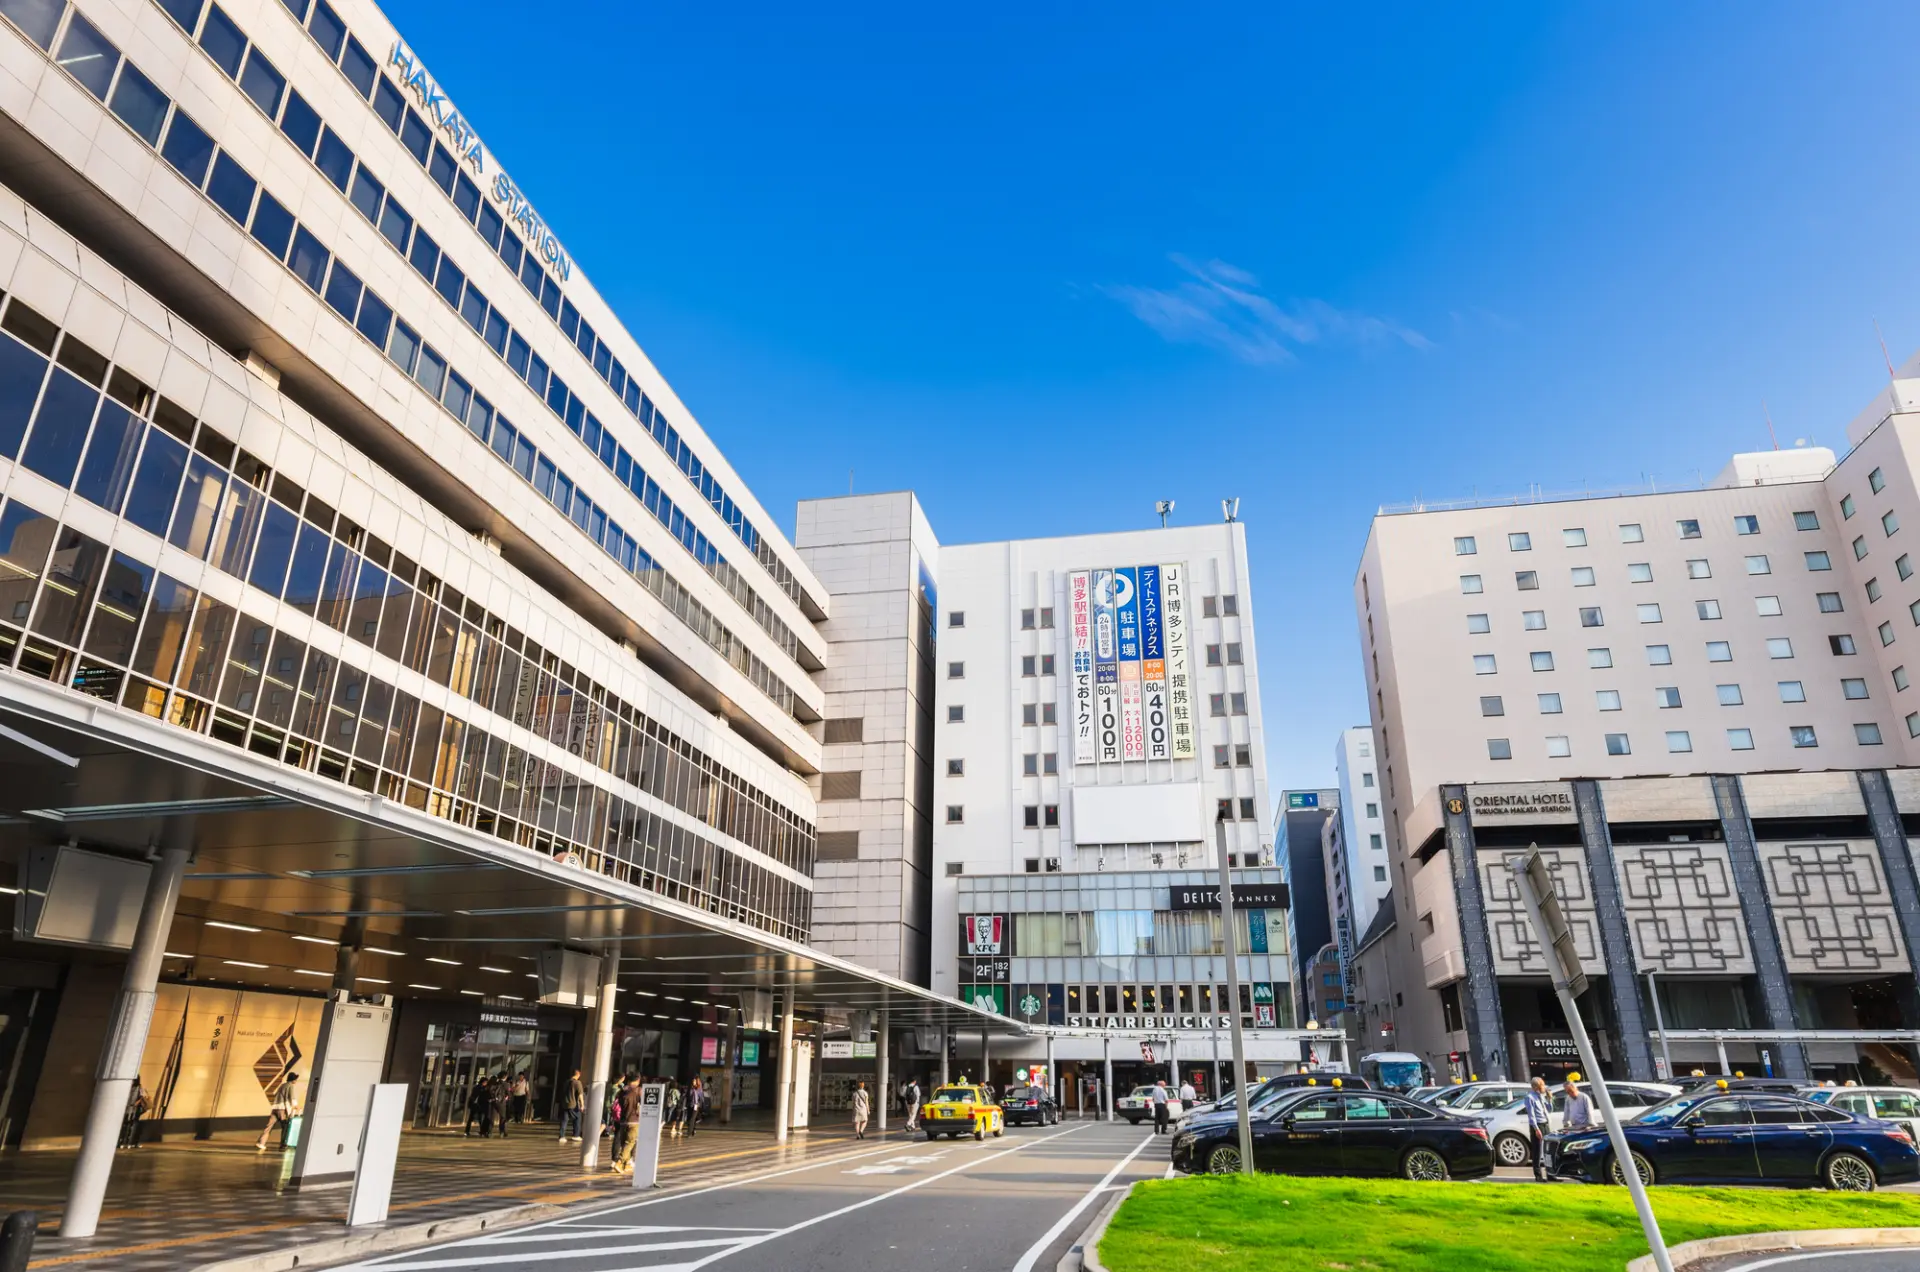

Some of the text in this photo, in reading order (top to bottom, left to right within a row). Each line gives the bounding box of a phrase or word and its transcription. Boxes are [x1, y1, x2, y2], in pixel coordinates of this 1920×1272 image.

[390, 39, 571, 281] HAKATA STATION
[1143, 570, 1159, 655] デイトスアネックス
[1120, 611, 1137, 656] 駐車場
[1167, 569, 1191, 753] JR博多シティ提携駐車場
[1098, 685, 1117, 696] 60分
[1146, 682, 1164, 692] 60分
[1077, 674, 1090, 737] でおトク!!
[1101, 697, 1116, 759] 100円
[1149, 694, 1165, 756] 400円
[1473, 793, 1571, 807] ORIENTAL HOTEL
[1475, 805, 1572, 815] FUKUOKA HAKATA STATION
[1239, 895, 1277, 903] ANNEX
[975, 944, 996, 953] KFC
[976, 965, 992, 976] 2F
[994, 962, 1009, 970] 182
[1070, 1016, 1231, 1028] STARBUCKS
[210, 1016, 224, 1050] 博多駅
[1546, 1047, 1580, 1055] COFFE
